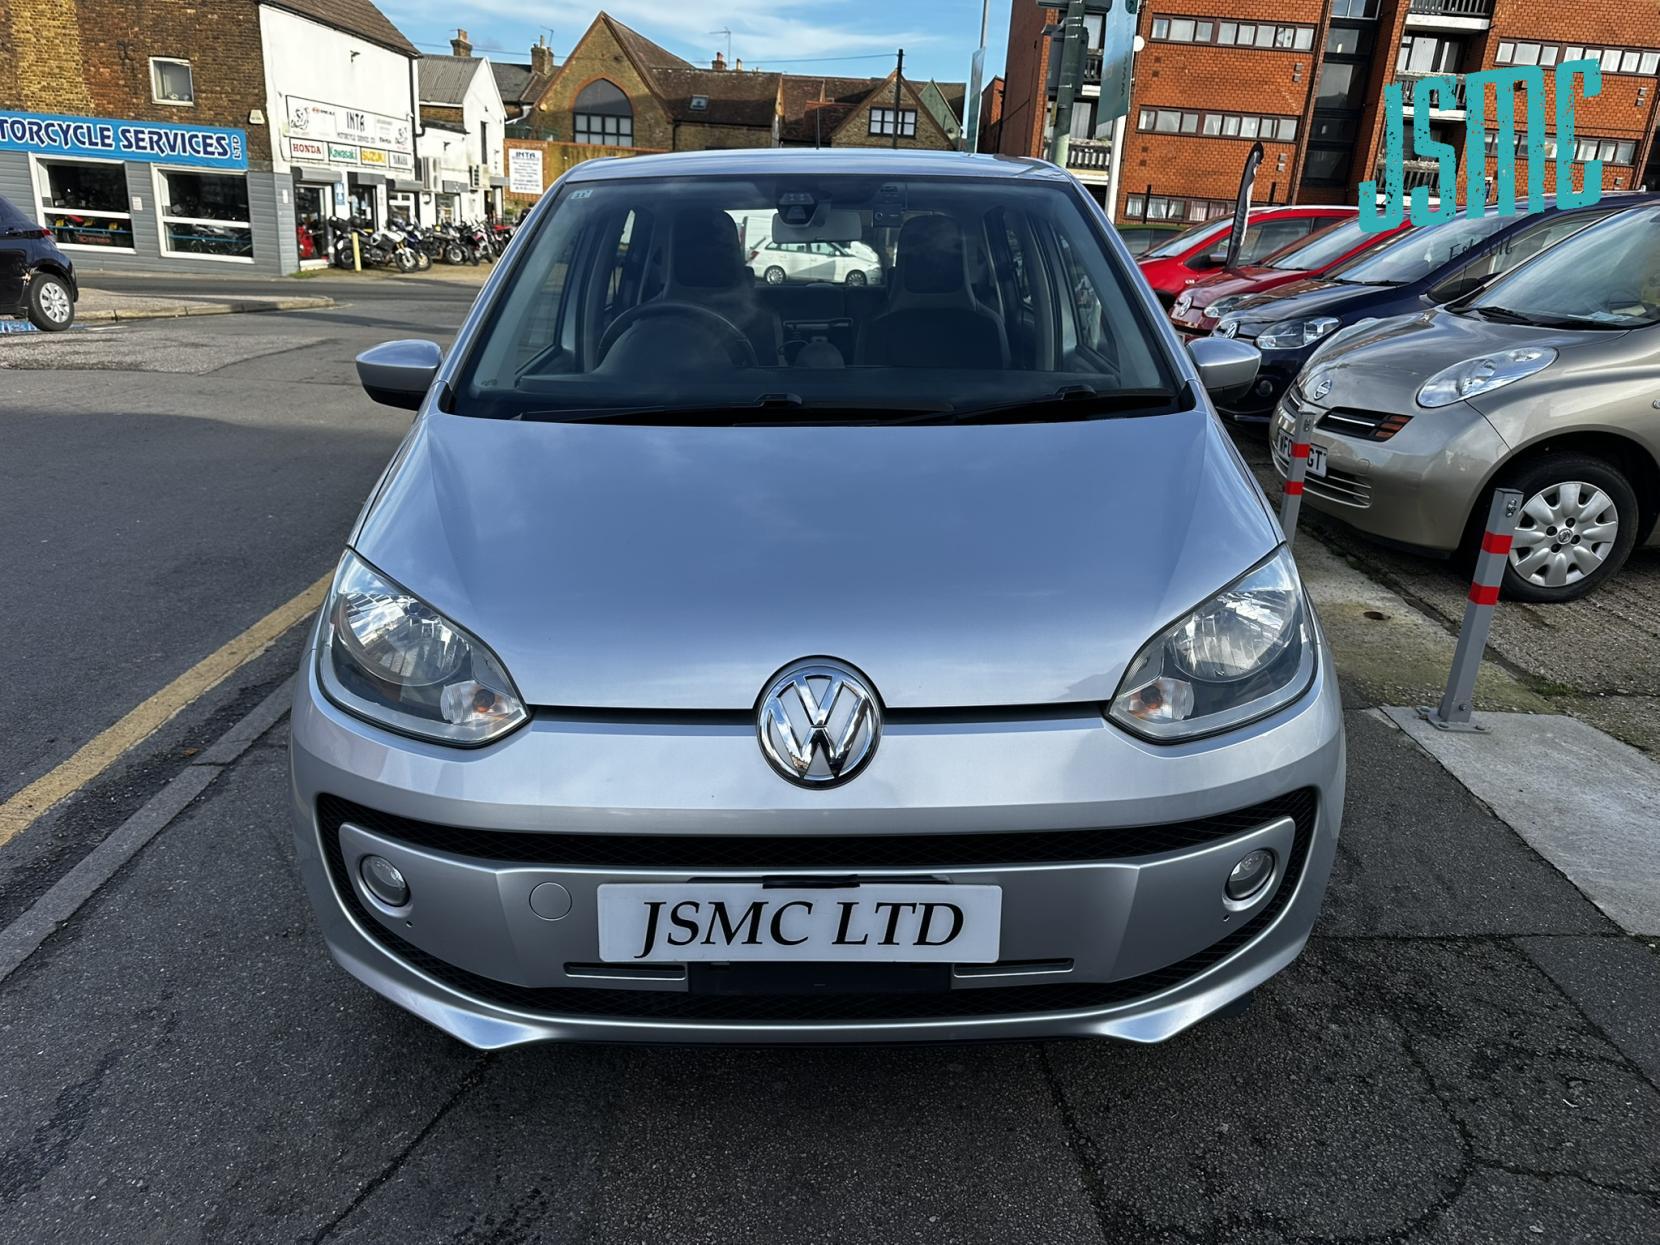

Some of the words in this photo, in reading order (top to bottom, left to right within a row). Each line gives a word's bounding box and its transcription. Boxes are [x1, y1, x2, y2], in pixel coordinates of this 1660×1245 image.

[119, 127, 230, 157] SERVICES
[231, 135, 241, 159] LTD
[292, 143, 322, 155] HONDA
[759, 664, 880, 784] VW
[634, 900, 814, 959] JSMC
[832, 901, 964, 946] LTD
